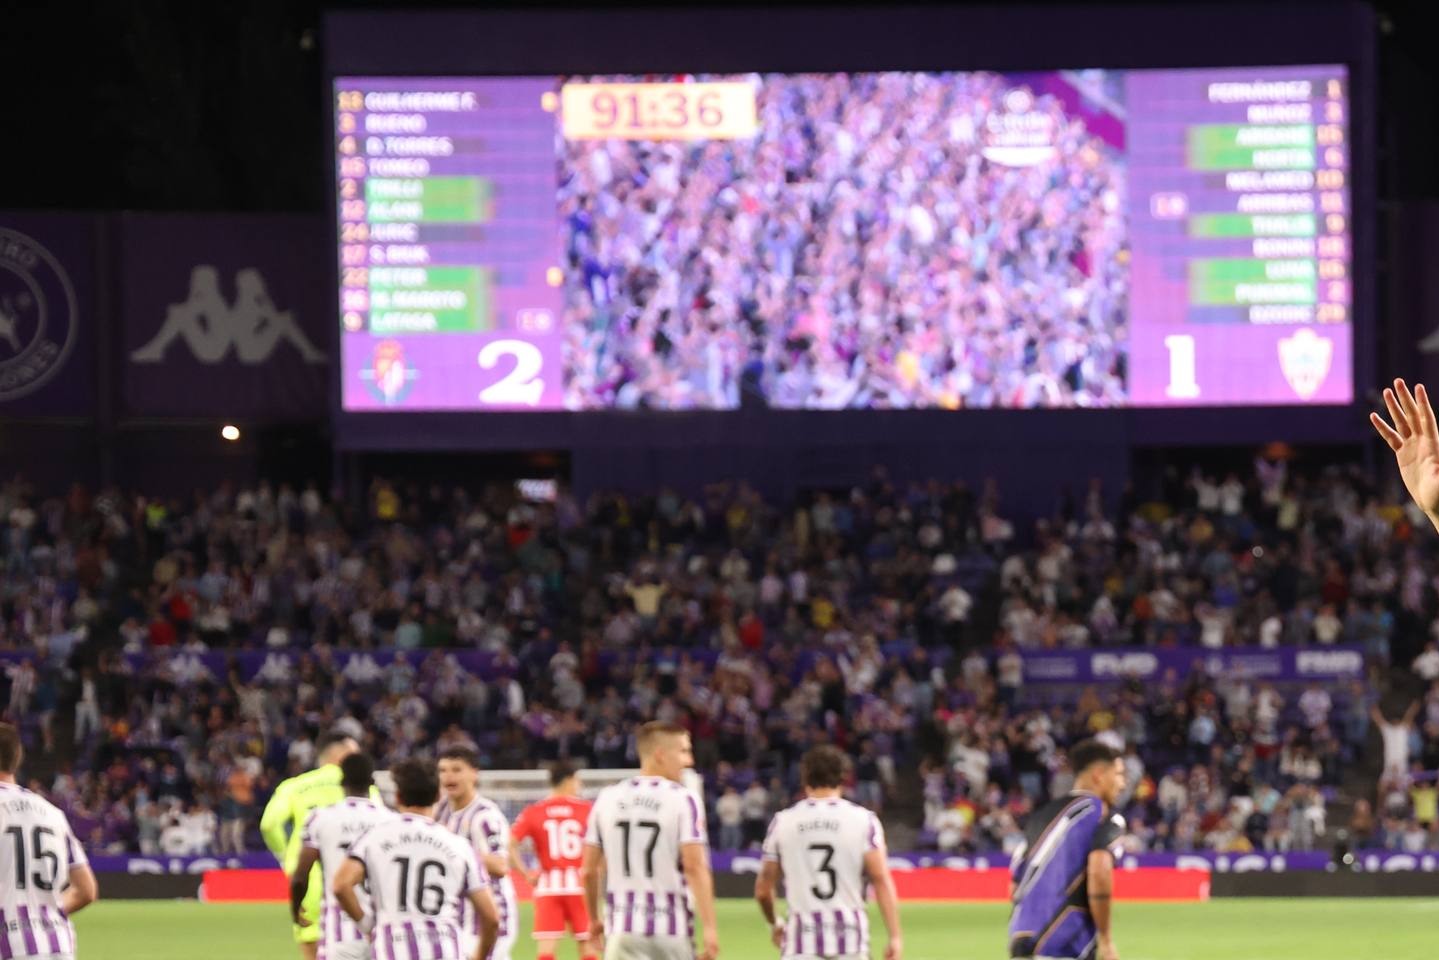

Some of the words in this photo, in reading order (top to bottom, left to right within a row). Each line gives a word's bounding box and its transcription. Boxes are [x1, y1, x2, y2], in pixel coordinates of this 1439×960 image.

[590, 91, 724, 130] 91:36
[477, 338, 544, 405] 2
[1164, 335, 1201, 398] 1
[5, 826, 59, 891] 15
[543, 819, 583, 860] 16
[616, 821, 661, 878] 17
[392, 856, 447, 916] 16
[808, 843, 837, 900] 3
